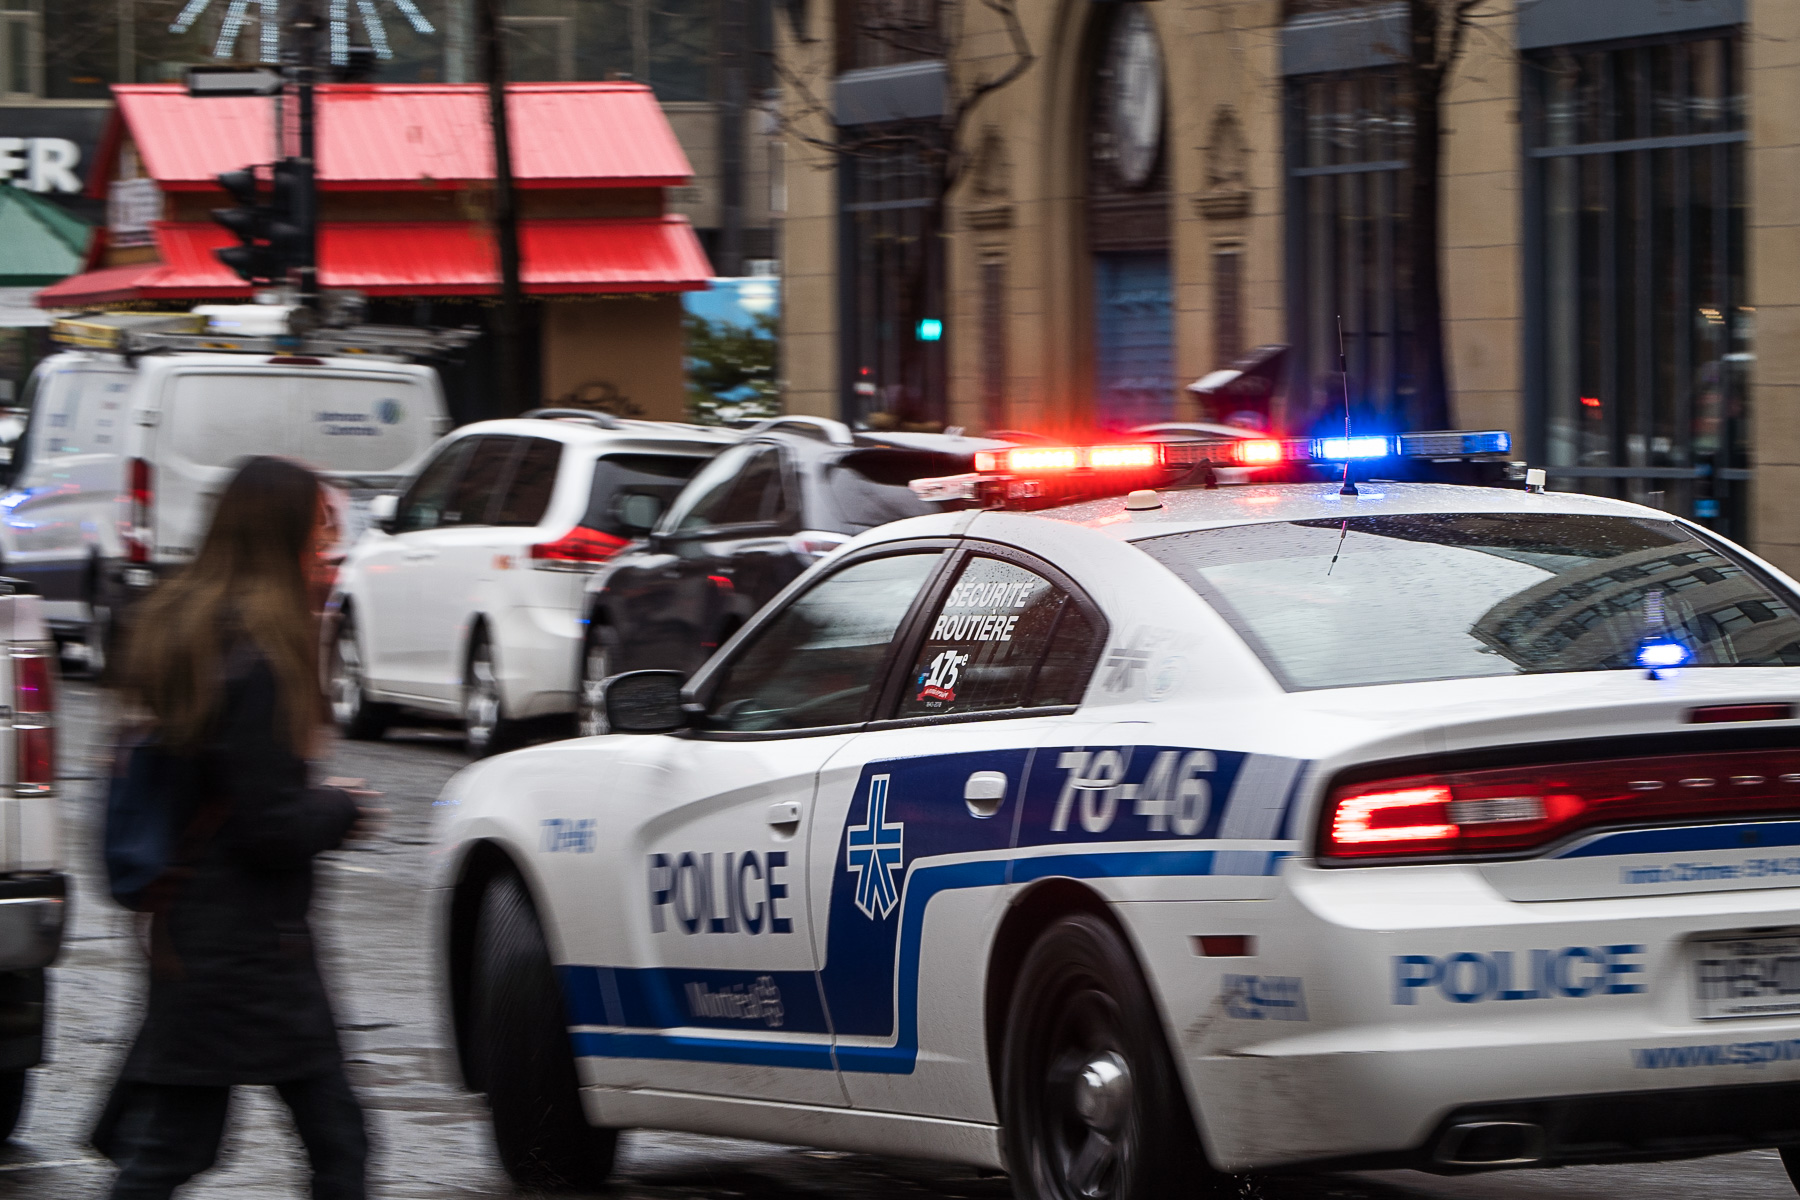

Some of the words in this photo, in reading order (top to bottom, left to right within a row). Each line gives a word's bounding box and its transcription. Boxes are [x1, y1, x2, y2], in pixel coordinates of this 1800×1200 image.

[945, 577, 1036, 608] SÉCURITÉ
[929, 608, 1019, 641] ROUTIÈRE
[1050, 750, 1218, 836] 70-46
[647, 850, 794, 935] POLICE
[1389, 944, 1647, 1005] POLICE
